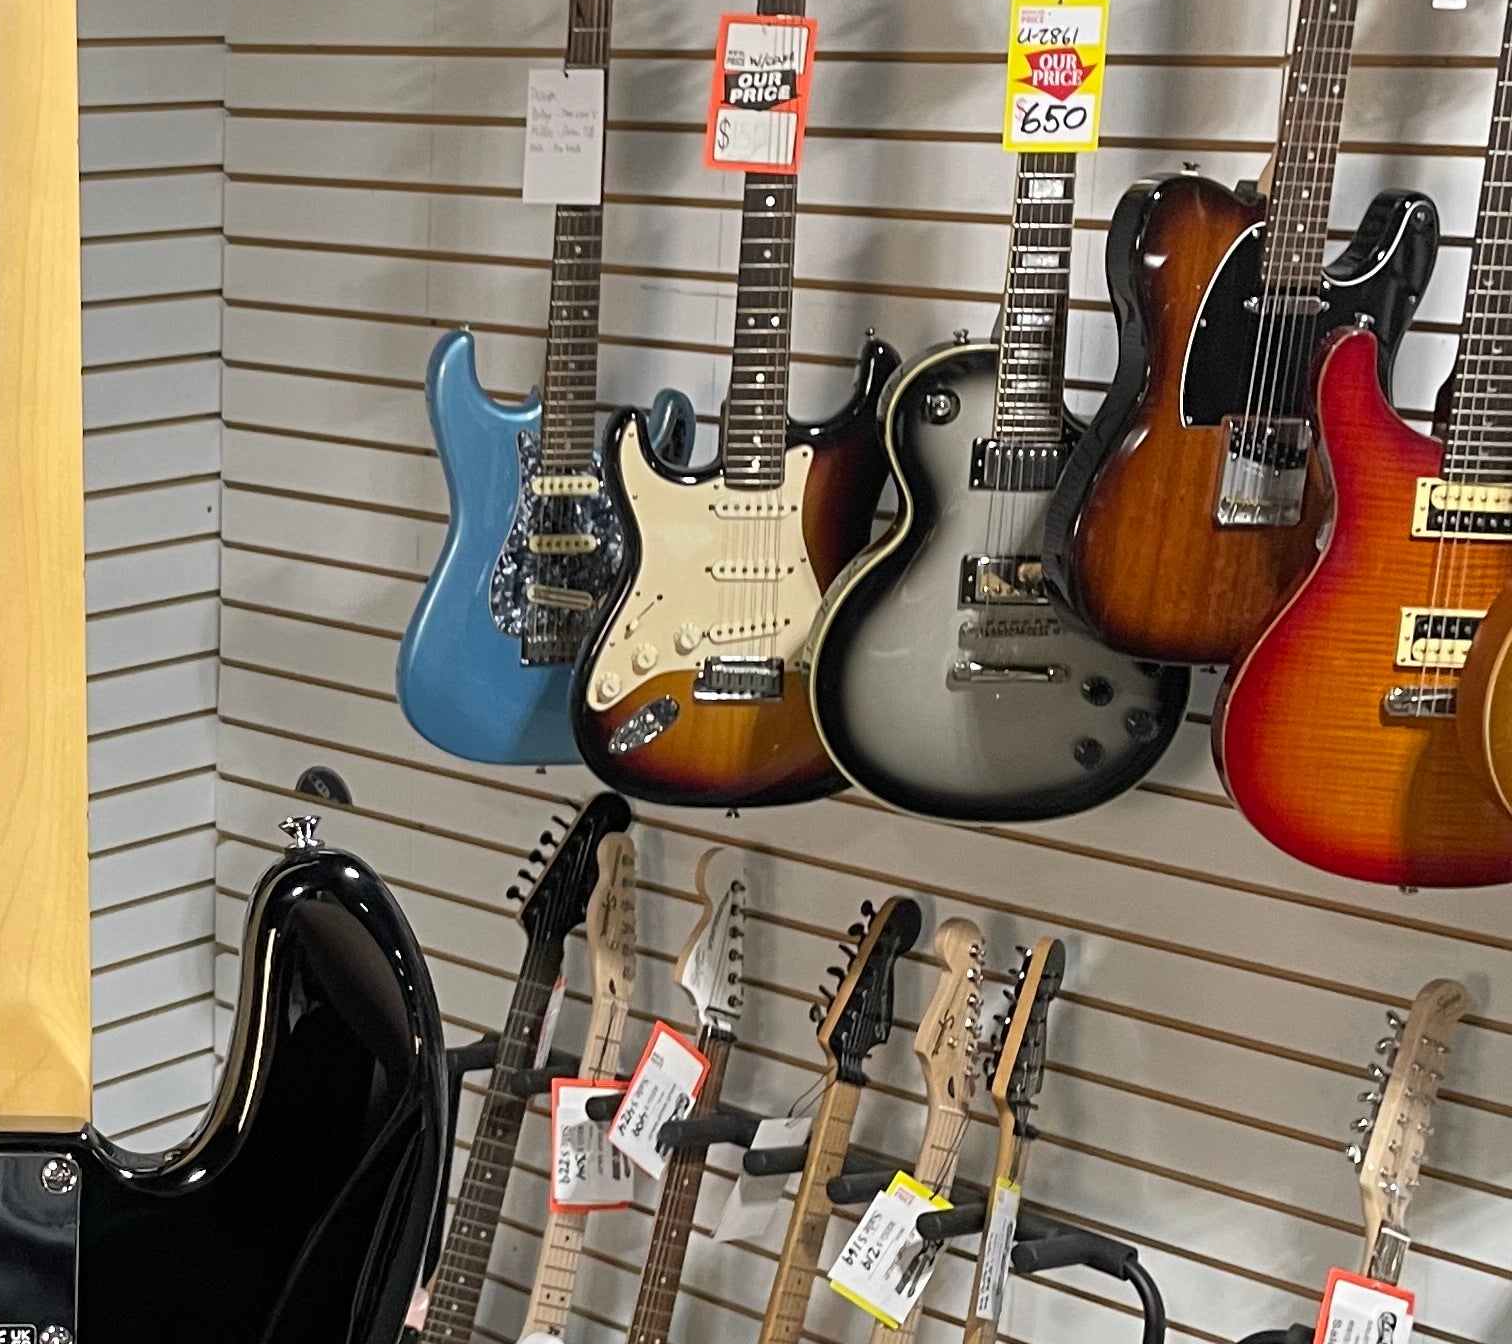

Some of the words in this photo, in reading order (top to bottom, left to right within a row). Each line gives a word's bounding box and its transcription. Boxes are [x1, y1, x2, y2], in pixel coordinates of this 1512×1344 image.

[1039, 53, 1078, 70] OUR
[738, 71, 782, 89] OUR
[1032, 69, 1084, 87] PRICE
[730, 86, 791, 104] PRICE
[11, 1330, 31, 1341] UK
